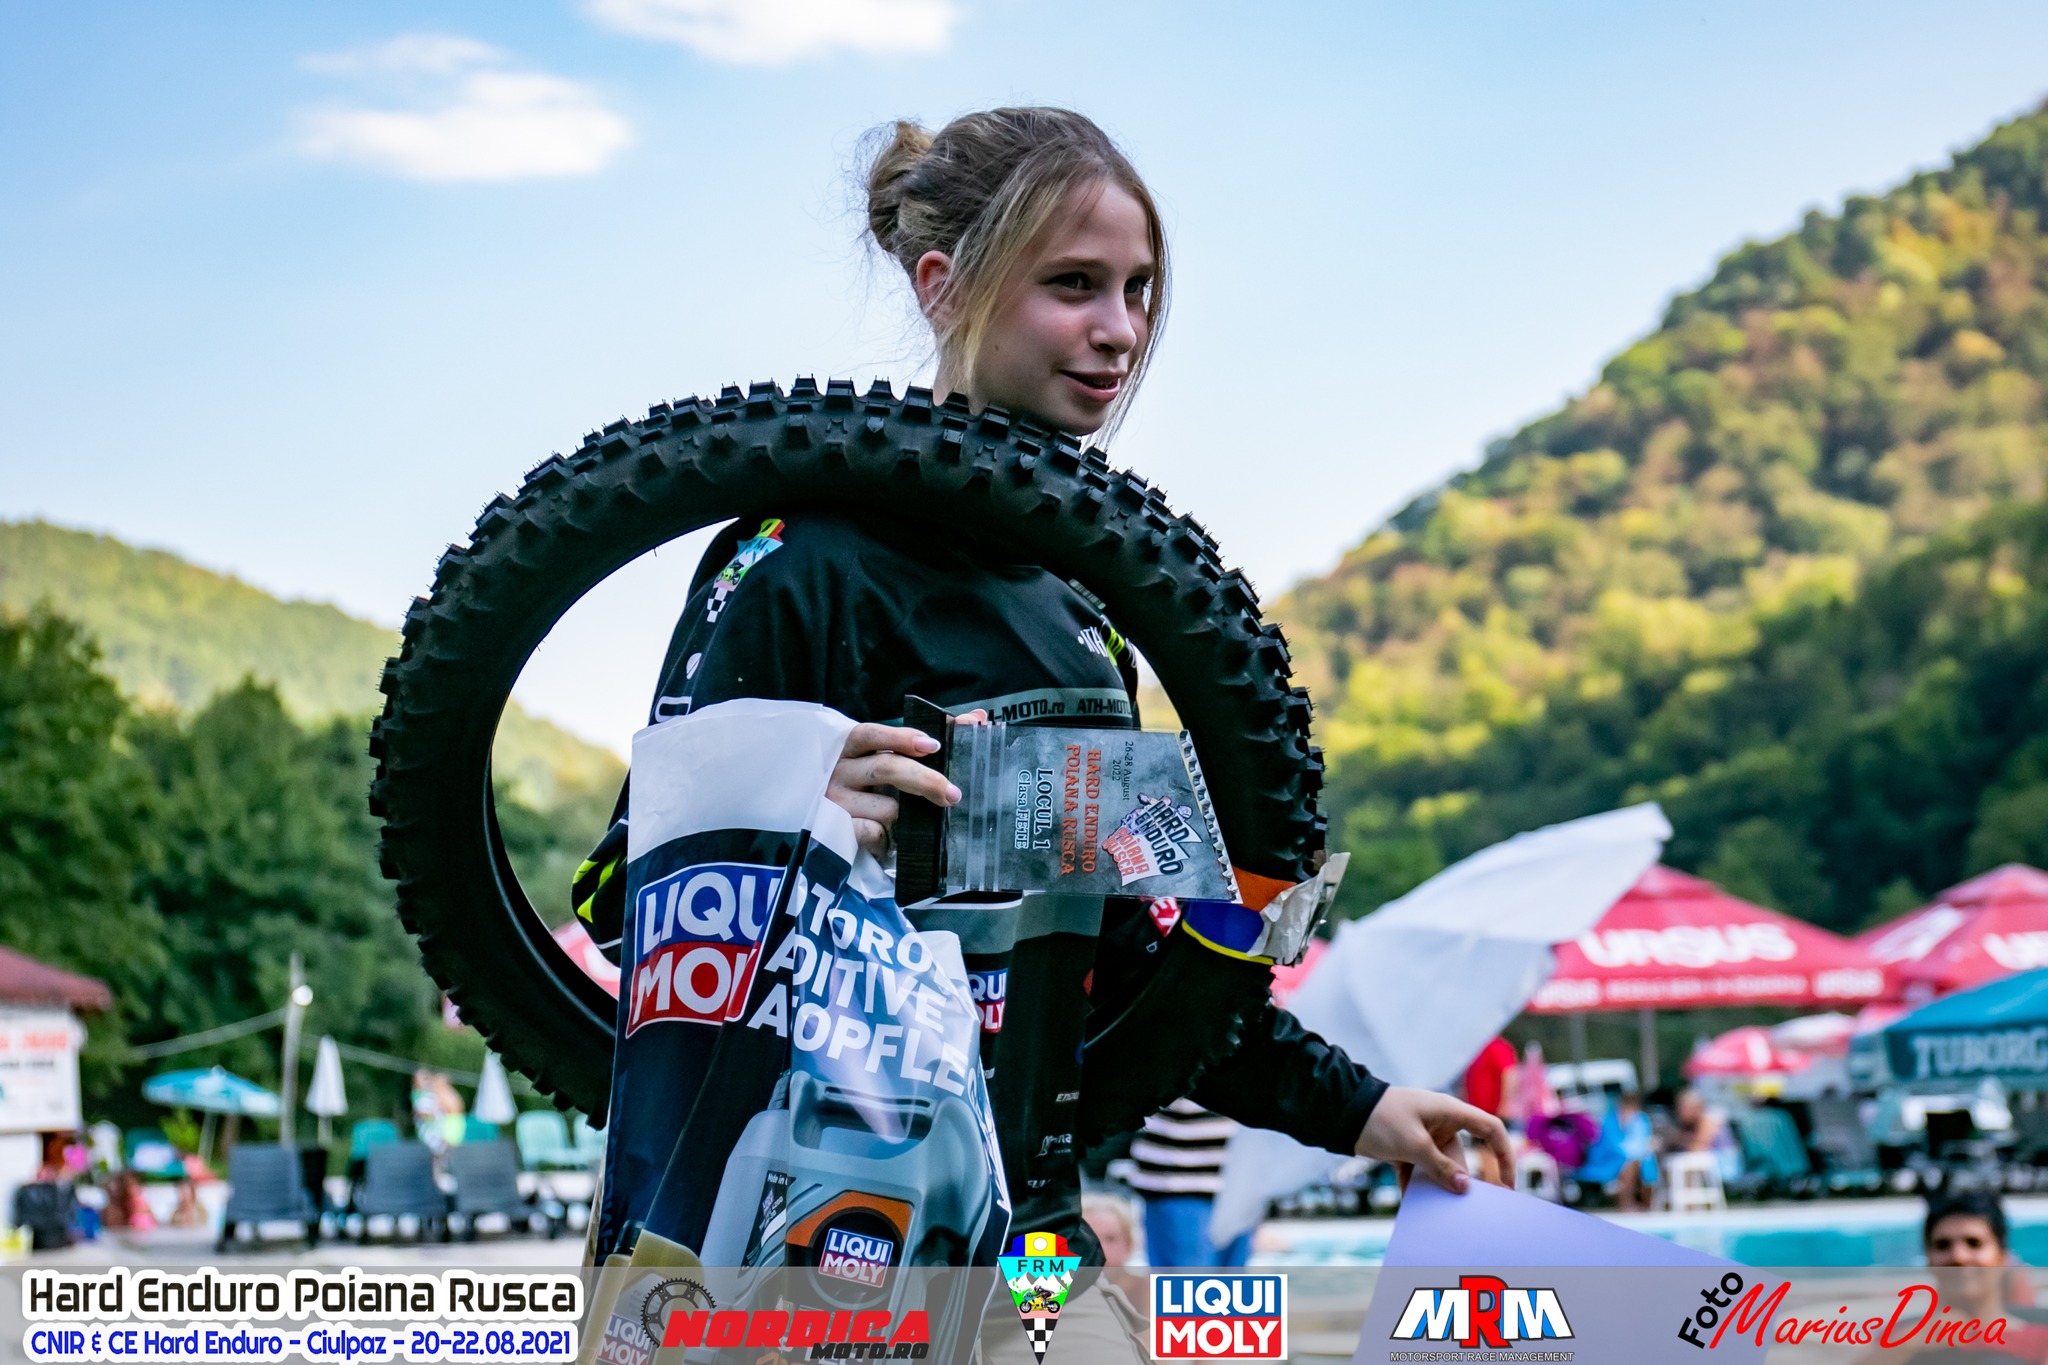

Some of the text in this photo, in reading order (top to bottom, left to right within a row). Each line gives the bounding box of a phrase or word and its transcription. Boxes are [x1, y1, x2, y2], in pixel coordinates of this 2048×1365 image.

[1112, 759, 1122, 781] 2022
[1121, 741, 1134, 801] 26-28 August
[1014, 770, 1032, 850] Clasa FETE
[1032, 767, 1054, 850] LOCUL 1
[1060, 744, 1081, 875] POIANA RUSCA
[1081, 750, 1102, 873] HARD ENDURO
[1147, 800, 1190, 842] HARD
[1114, 826, 1151, 874] POIANA
[1135, 812, 1184, 875] ENDURO
[643, 872, 781, 955] LIQU
[822, 1254, 885, 1284] MOLY
[829, 1232, 889, 1262] LIQUI
